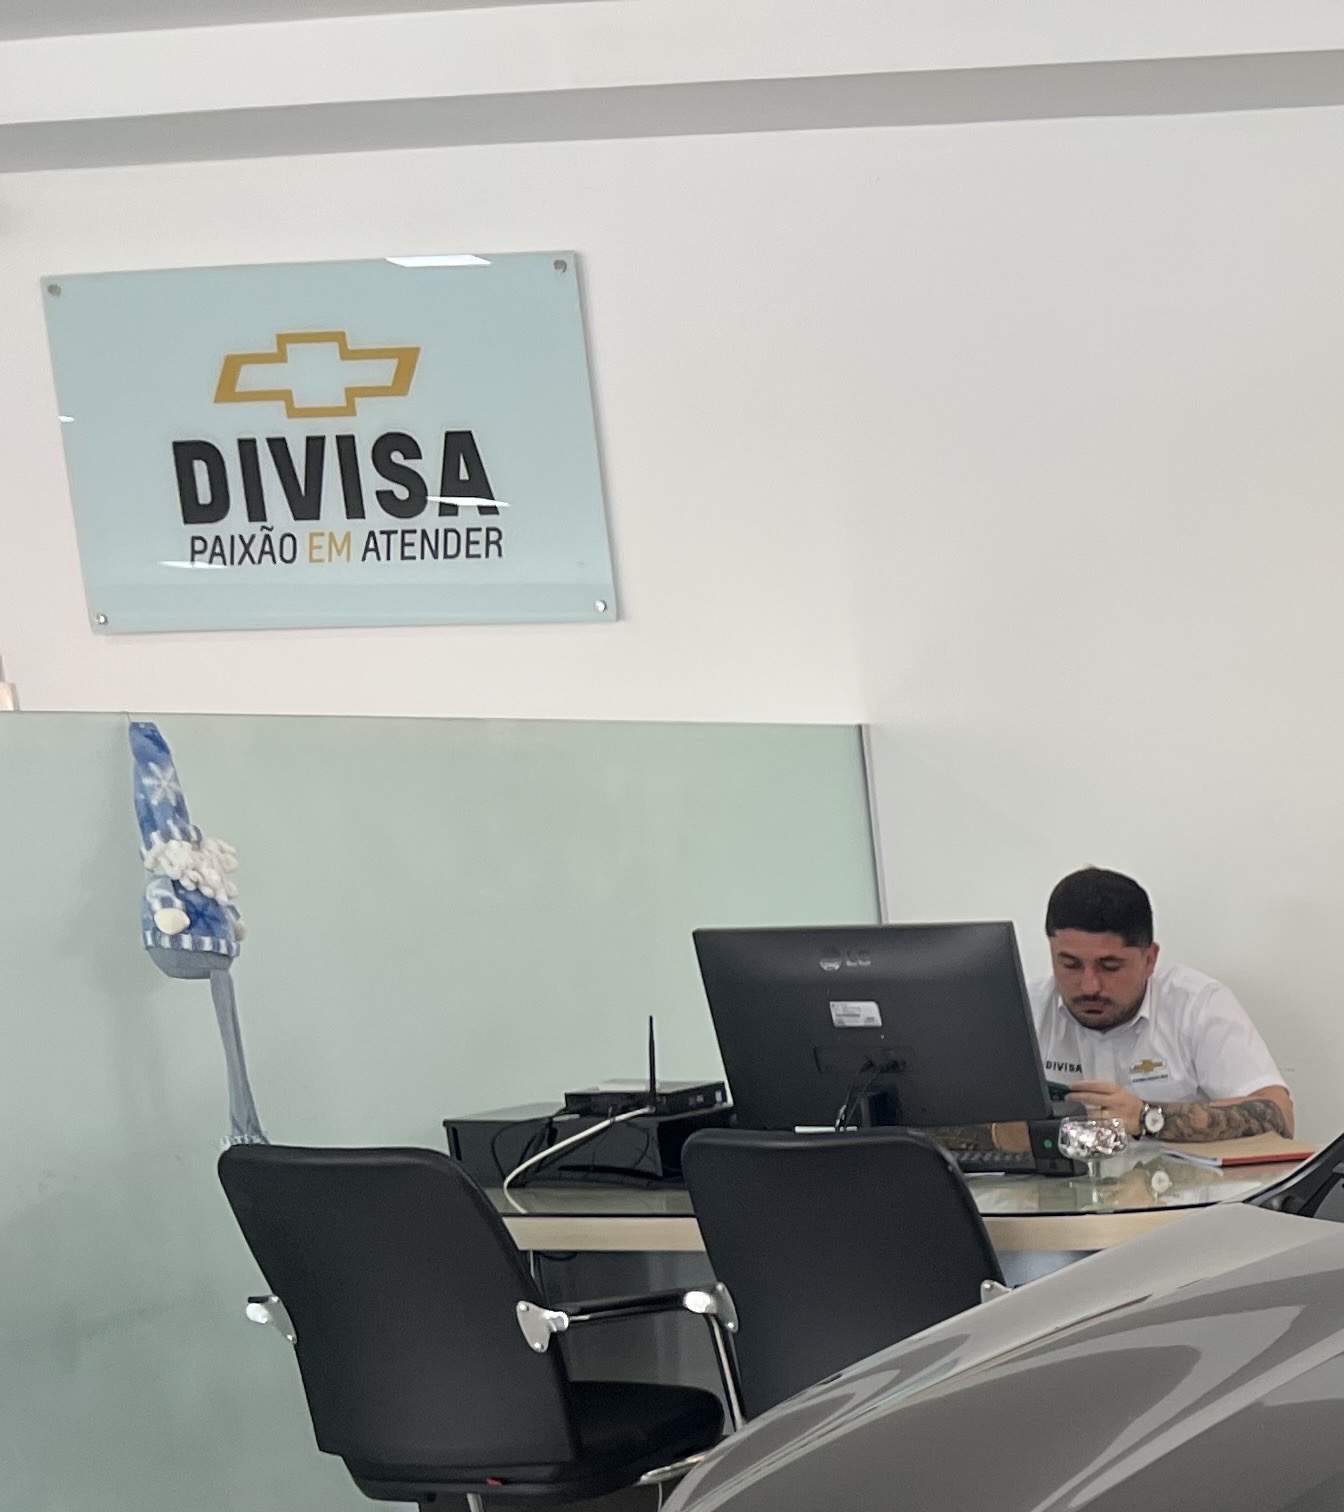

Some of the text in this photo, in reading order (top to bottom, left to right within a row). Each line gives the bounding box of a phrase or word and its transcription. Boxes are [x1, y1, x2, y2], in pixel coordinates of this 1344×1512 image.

[172, 430, 500, 525] DIVISA
[190, 525, 504, 566] PAIXÃO EM ATENDER
[1045, 1060, 1083, 1074] DIVISA
